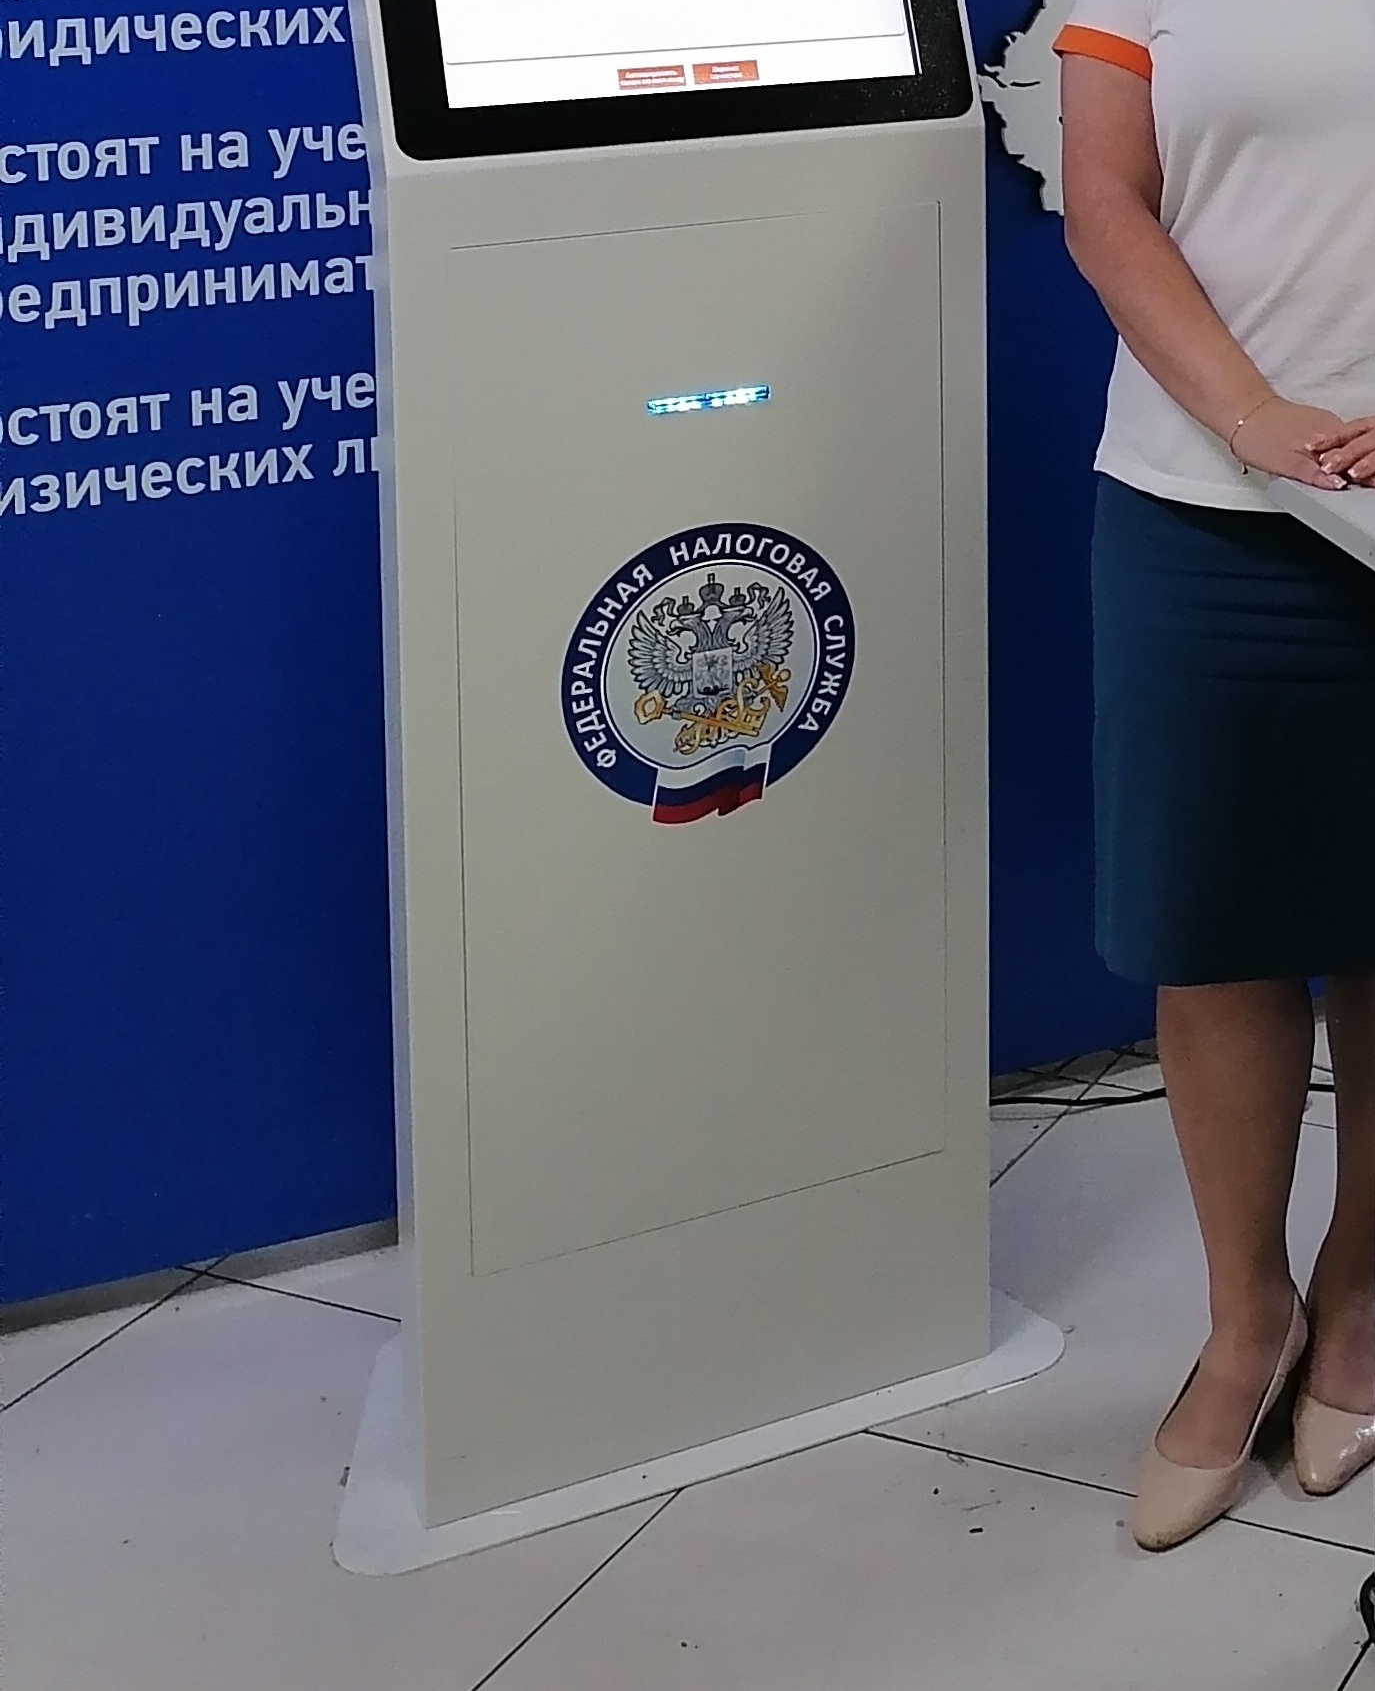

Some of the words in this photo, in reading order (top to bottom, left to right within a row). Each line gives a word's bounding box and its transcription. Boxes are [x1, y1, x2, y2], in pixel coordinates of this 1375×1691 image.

[181, 130, 249, 174] на
[268, 123, 368, 179] уче
[191, 382, 259, 427] на
[278, 371, 376, 429] уче
[570, 563, 654, 769] ФЕДЕРАЛЬНАЯ
[669, 533, 832, 601] НАЛОГОВАЯ
[797, 614, 847, 734] СЛУЖБА
